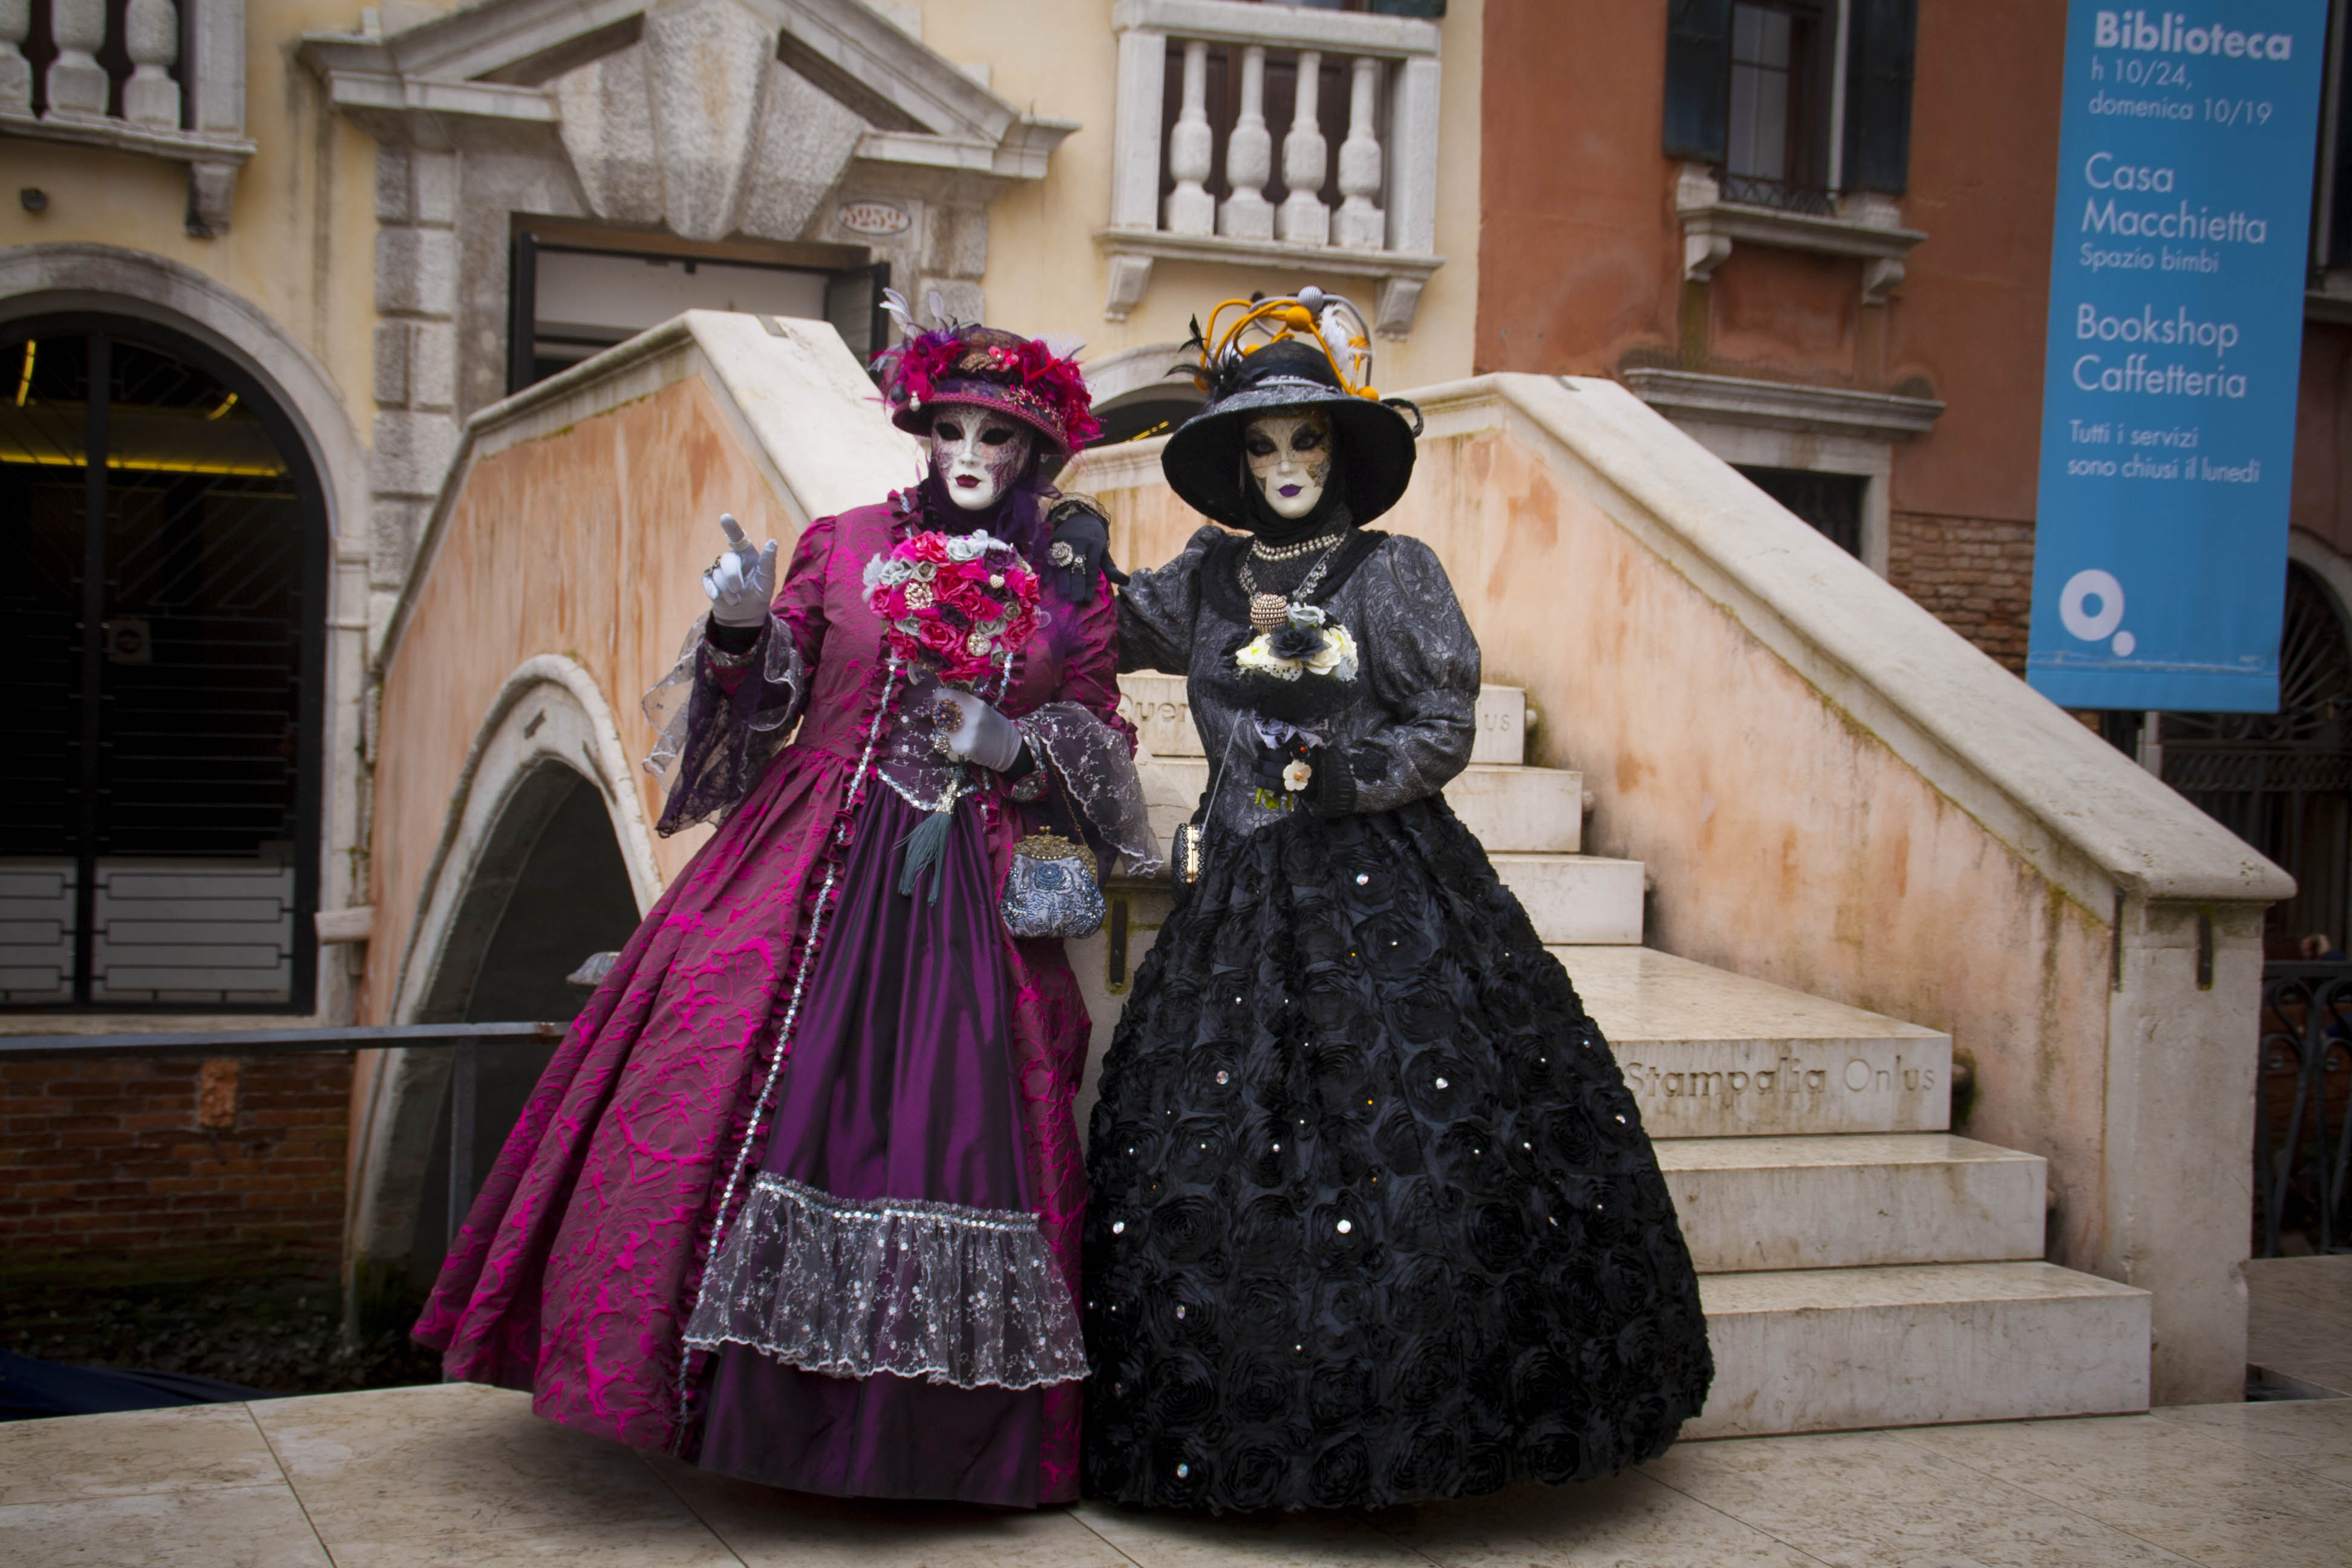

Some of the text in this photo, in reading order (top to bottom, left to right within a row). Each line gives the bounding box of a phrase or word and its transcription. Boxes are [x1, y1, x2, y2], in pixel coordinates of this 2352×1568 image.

[2094, 10, 2292, 60] Biblioteca
[2091, 55, 2104, 80] h
[2089, 89, 2273, 126] domenica 10/19
[2085, 151, 2174, 192] Casa
[2082, 197, 2267, 244] Macchietta
[2080, 242, 2219, 273] Spazio bimbi
[2077, 302, 2238, 358] Bookshop
[2073, 353, 2246, 397] Caffetteria
[2069, 419, 2198, 448] Tutti i servizi
[2067, 460, 2117, 477] sono
[2122, 454, 2178, 479] chiusi
[2185, 456, 2197, 480] il
[1624, 1056, 1936, 1096] Stampalia Onlus
